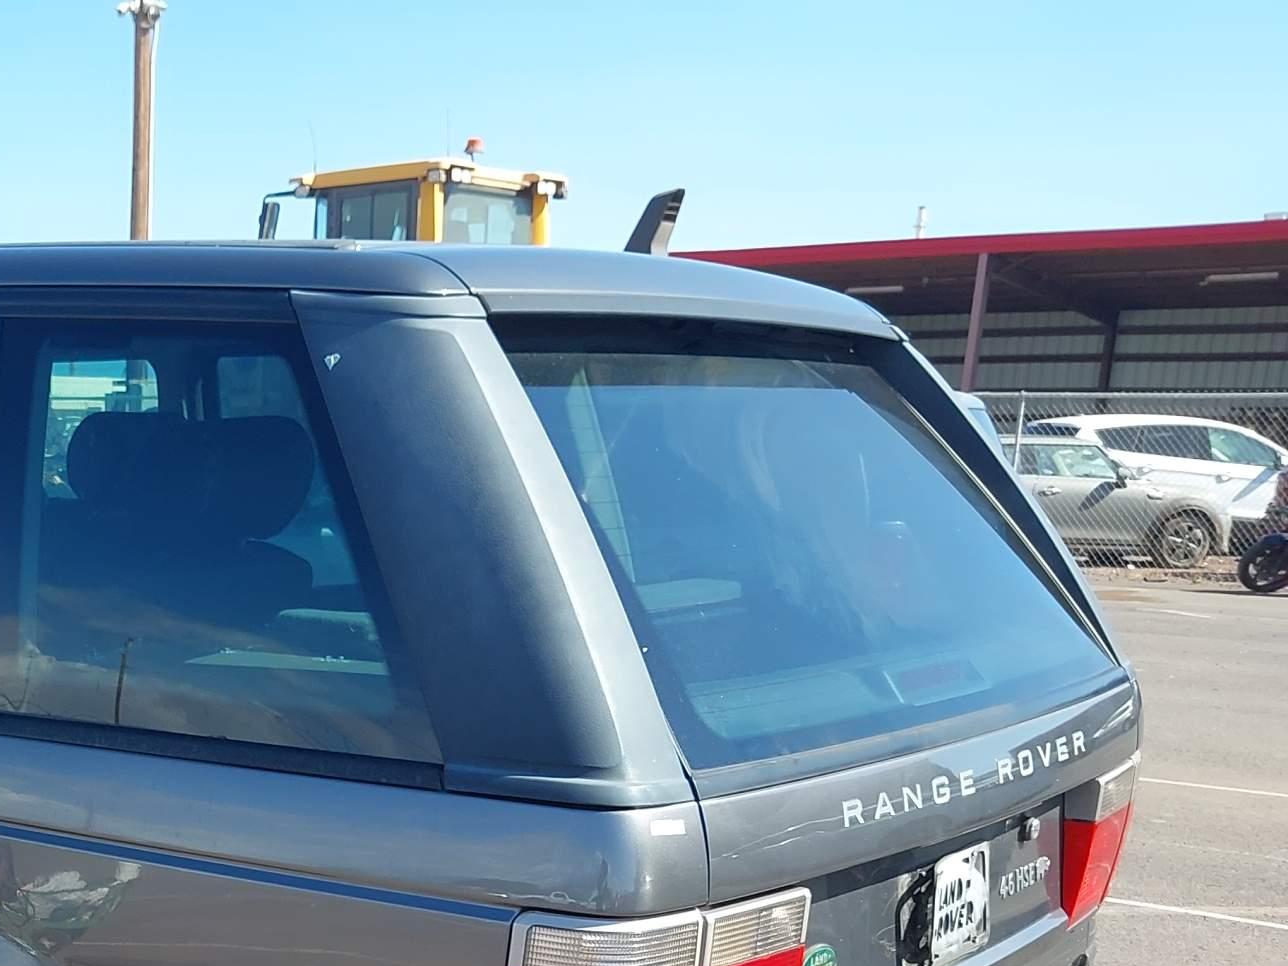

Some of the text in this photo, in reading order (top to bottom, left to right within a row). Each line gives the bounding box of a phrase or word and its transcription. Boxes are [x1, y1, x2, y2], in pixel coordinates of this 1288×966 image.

[842, 730, 1087, 828] RANGE ROVER
[938, 877, 964, 912] LAND
[935, 900, 974, 942] ROVER
